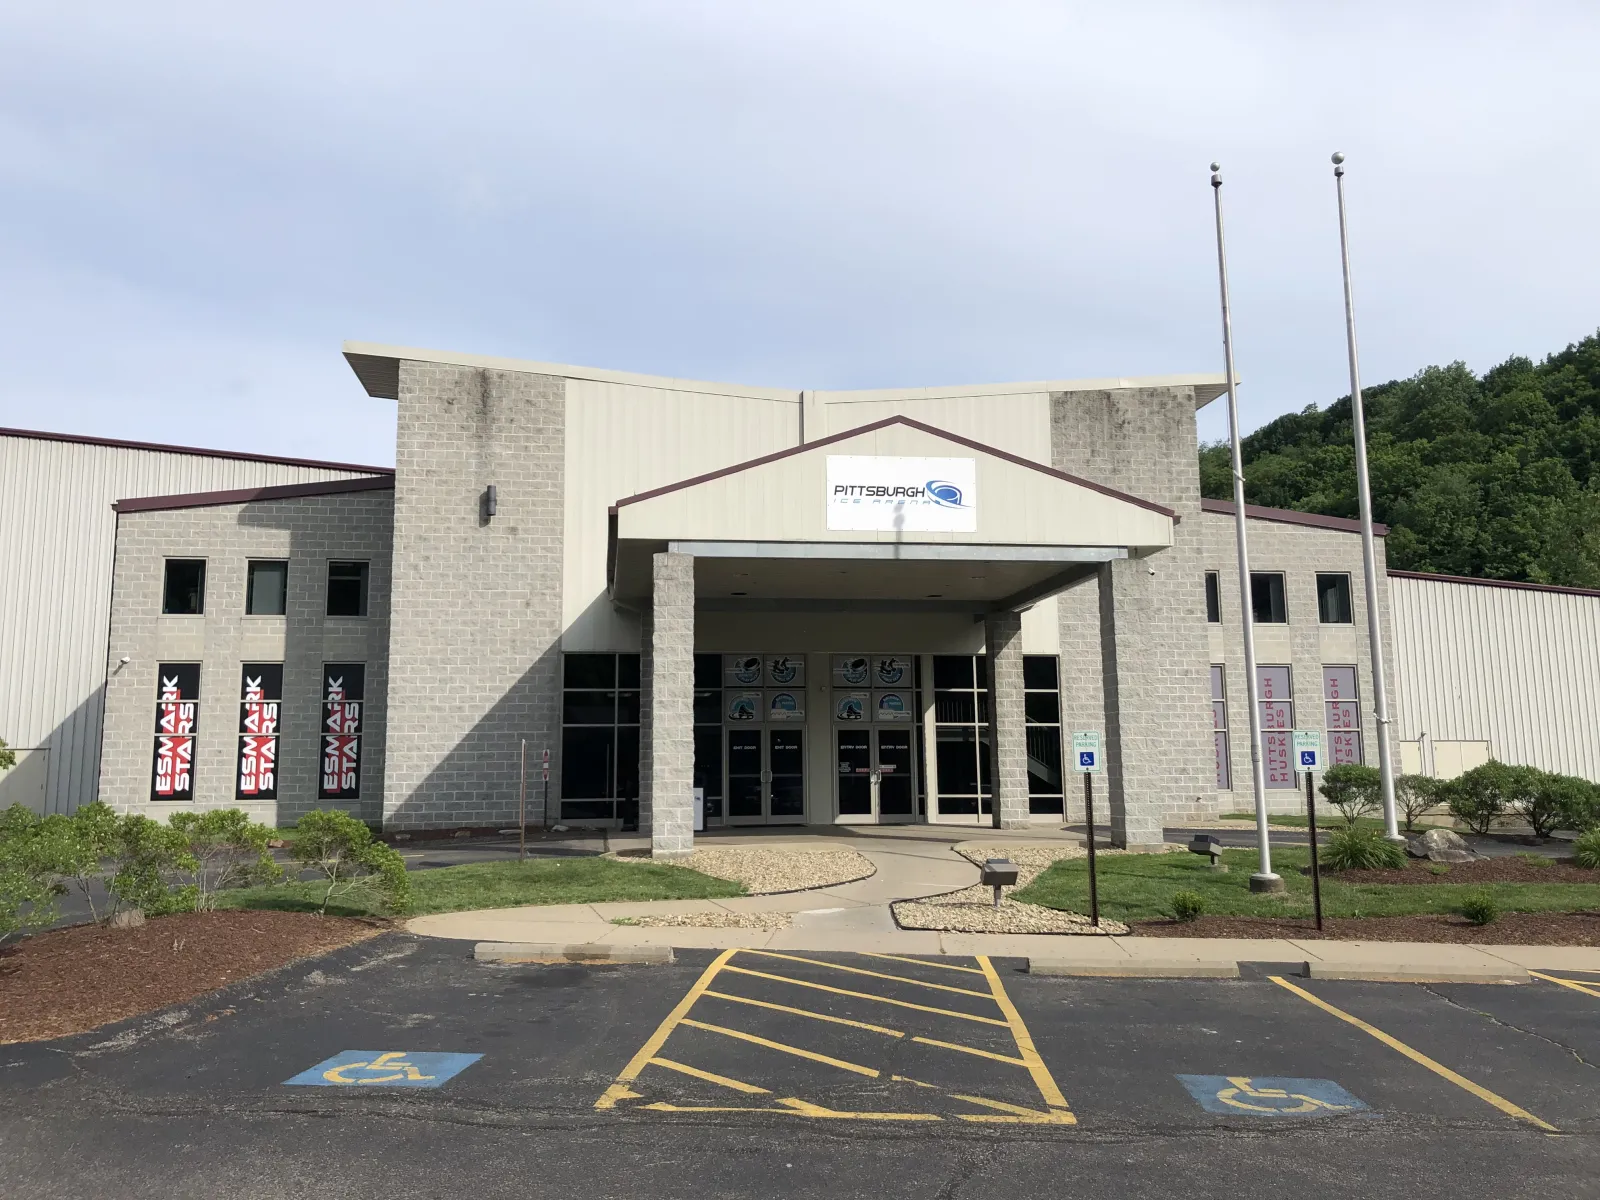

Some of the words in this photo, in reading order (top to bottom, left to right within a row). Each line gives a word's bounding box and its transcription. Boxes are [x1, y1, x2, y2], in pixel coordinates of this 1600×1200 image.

[834, 485, 925, 498] PITTSBURGH
[156, 675, 179, 791] ESMARK
[175, 702, 195, 791] STARS
[240, 675, 262, 791] ESMARK
[259, 702, 278, 791] STARS
[323, 676, 344, 790] ESMARK
[341, 702, 360, 790] STARS
[1264, 678, 1279, 782] PITTSBURGH
[1276, 708, 1289, 782] HUSKIES
[1329, 678, 1343, 764] TTSBURGH
